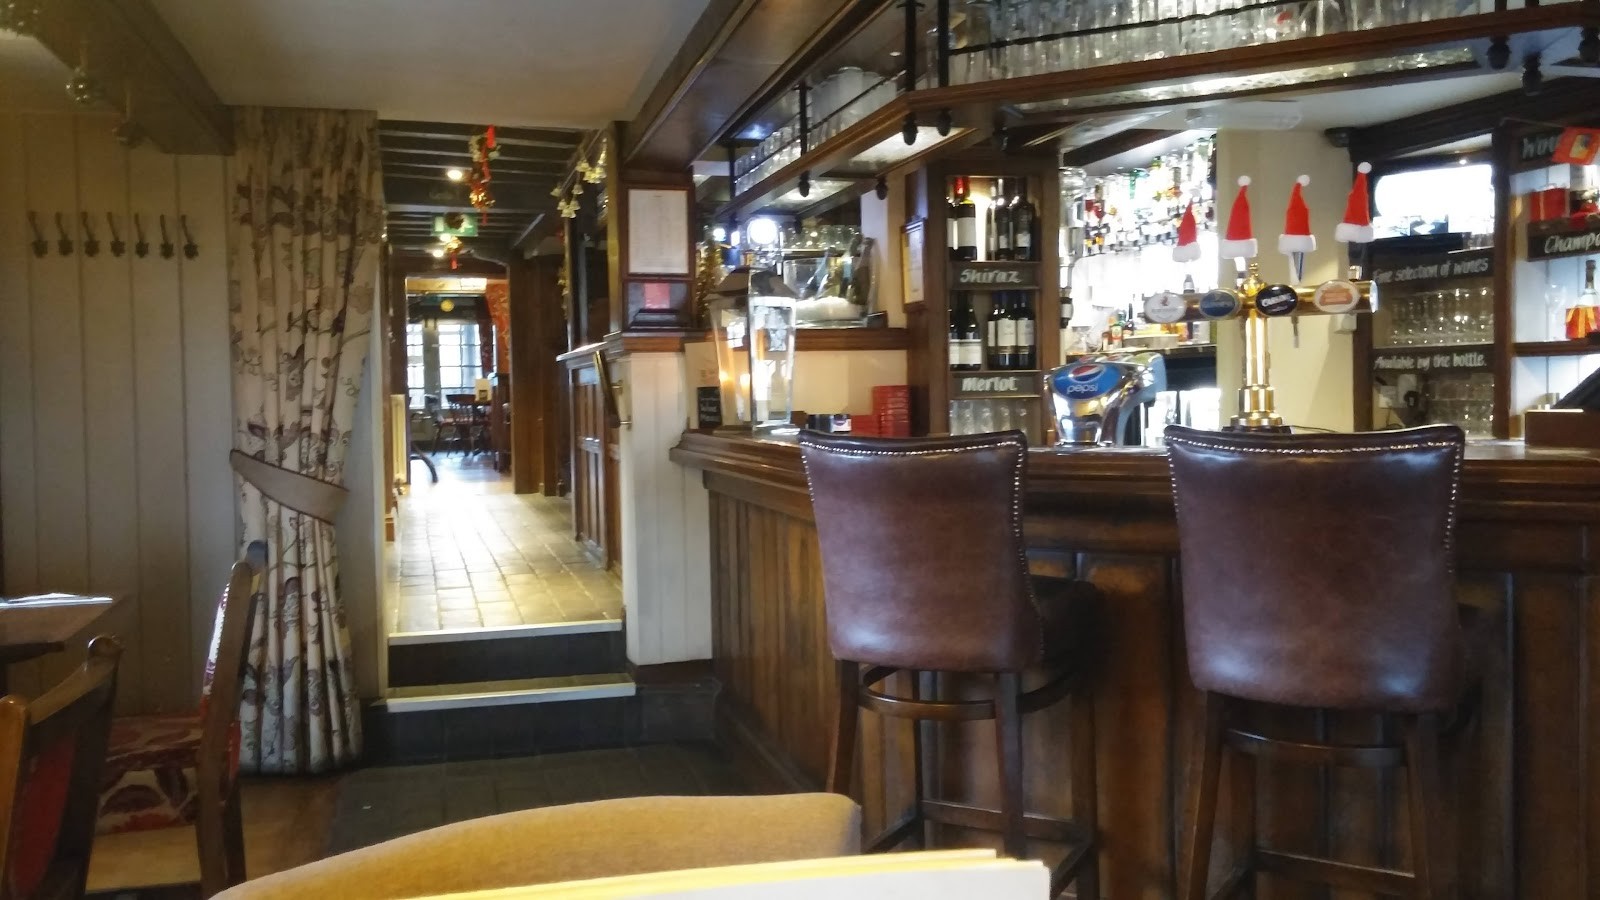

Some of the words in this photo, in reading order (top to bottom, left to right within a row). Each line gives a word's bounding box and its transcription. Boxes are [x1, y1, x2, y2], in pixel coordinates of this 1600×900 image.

[960, 268, 1021, 283] Shiraz
[1440, 260, 1452, 278] of
[961, 376, 1019, 392] Merlot
[1066, 382, 1099, 395] pepsi
